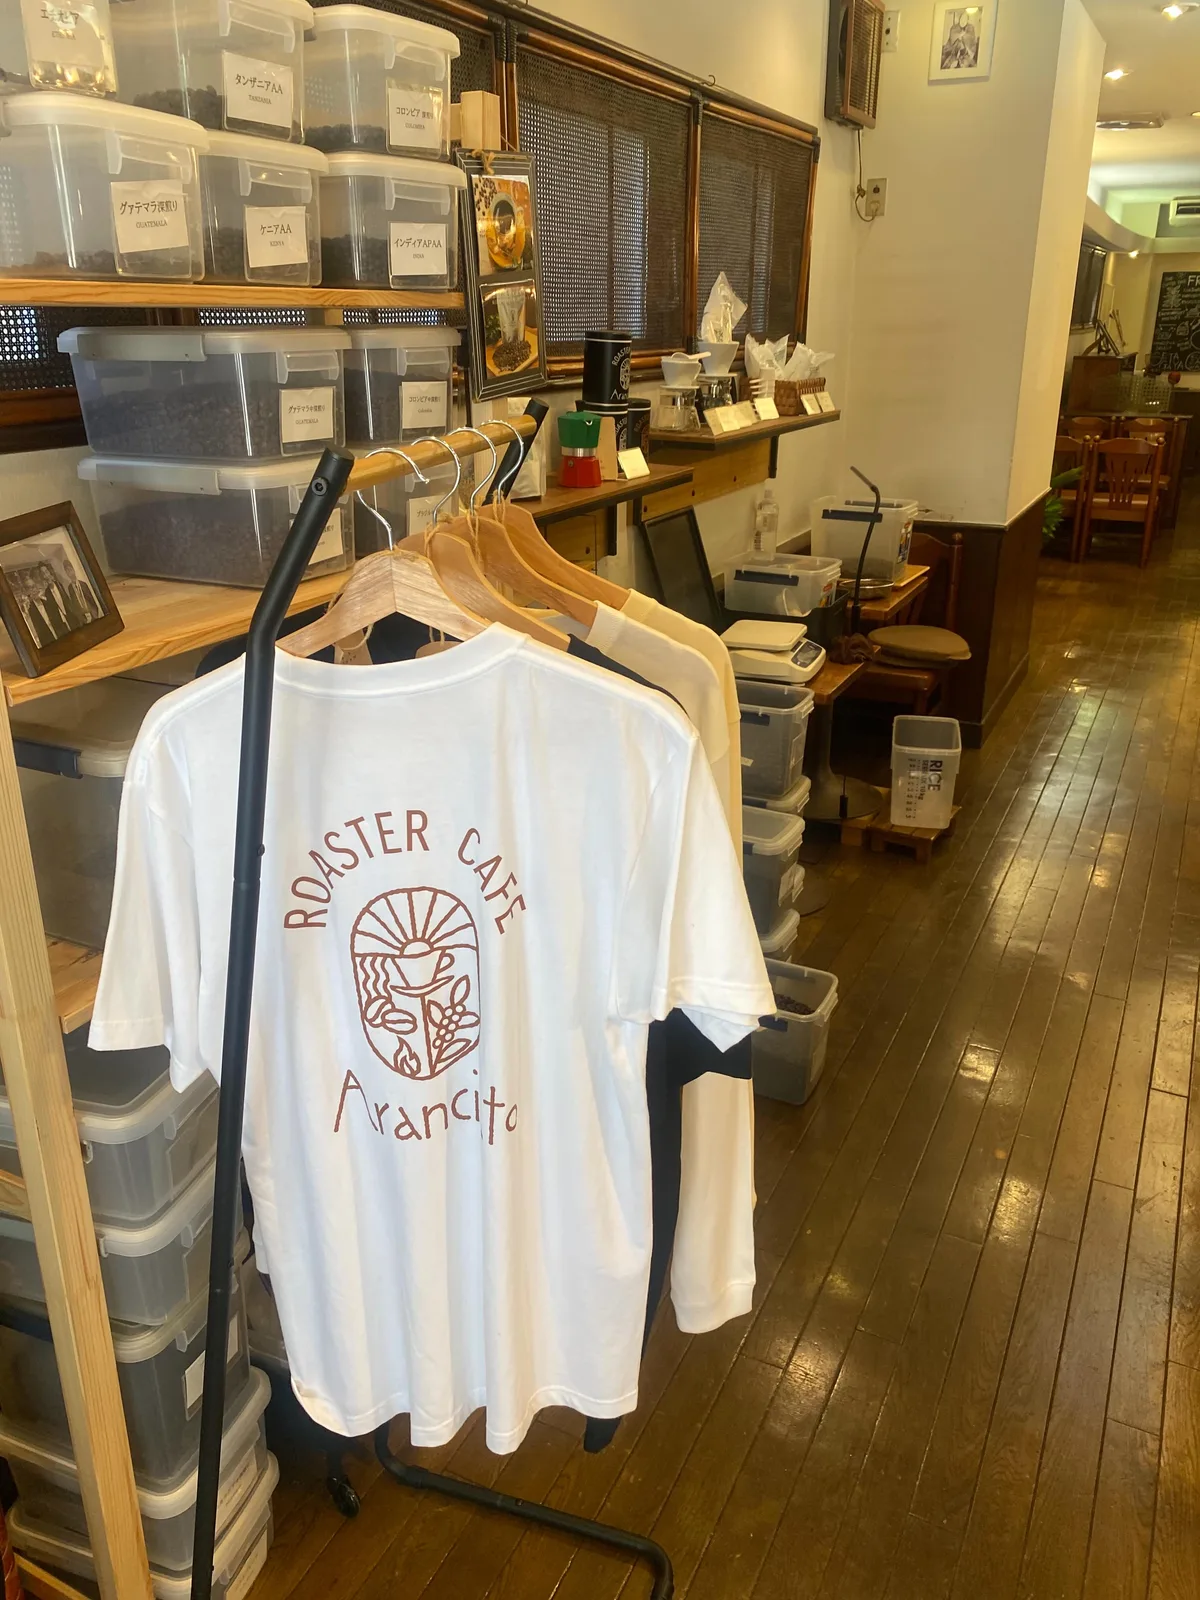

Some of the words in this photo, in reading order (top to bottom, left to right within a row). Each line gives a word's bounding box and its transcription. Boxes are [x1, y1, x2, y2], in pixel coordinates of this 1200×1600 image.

[235, 73, 283, 95] タンザニアAA
[136, 219, 168, 229] GUATEMALA
[260, 223, 292, 235] ケニアAA
[394, 237, 442, 248] インディアAPAA
[928, 760, 943, 791] RICE
[283, 809, 430, 929] ROASTER
[457, 827, 527, 935] CAFE
[333, 1068, 518, 1146] Arancito
